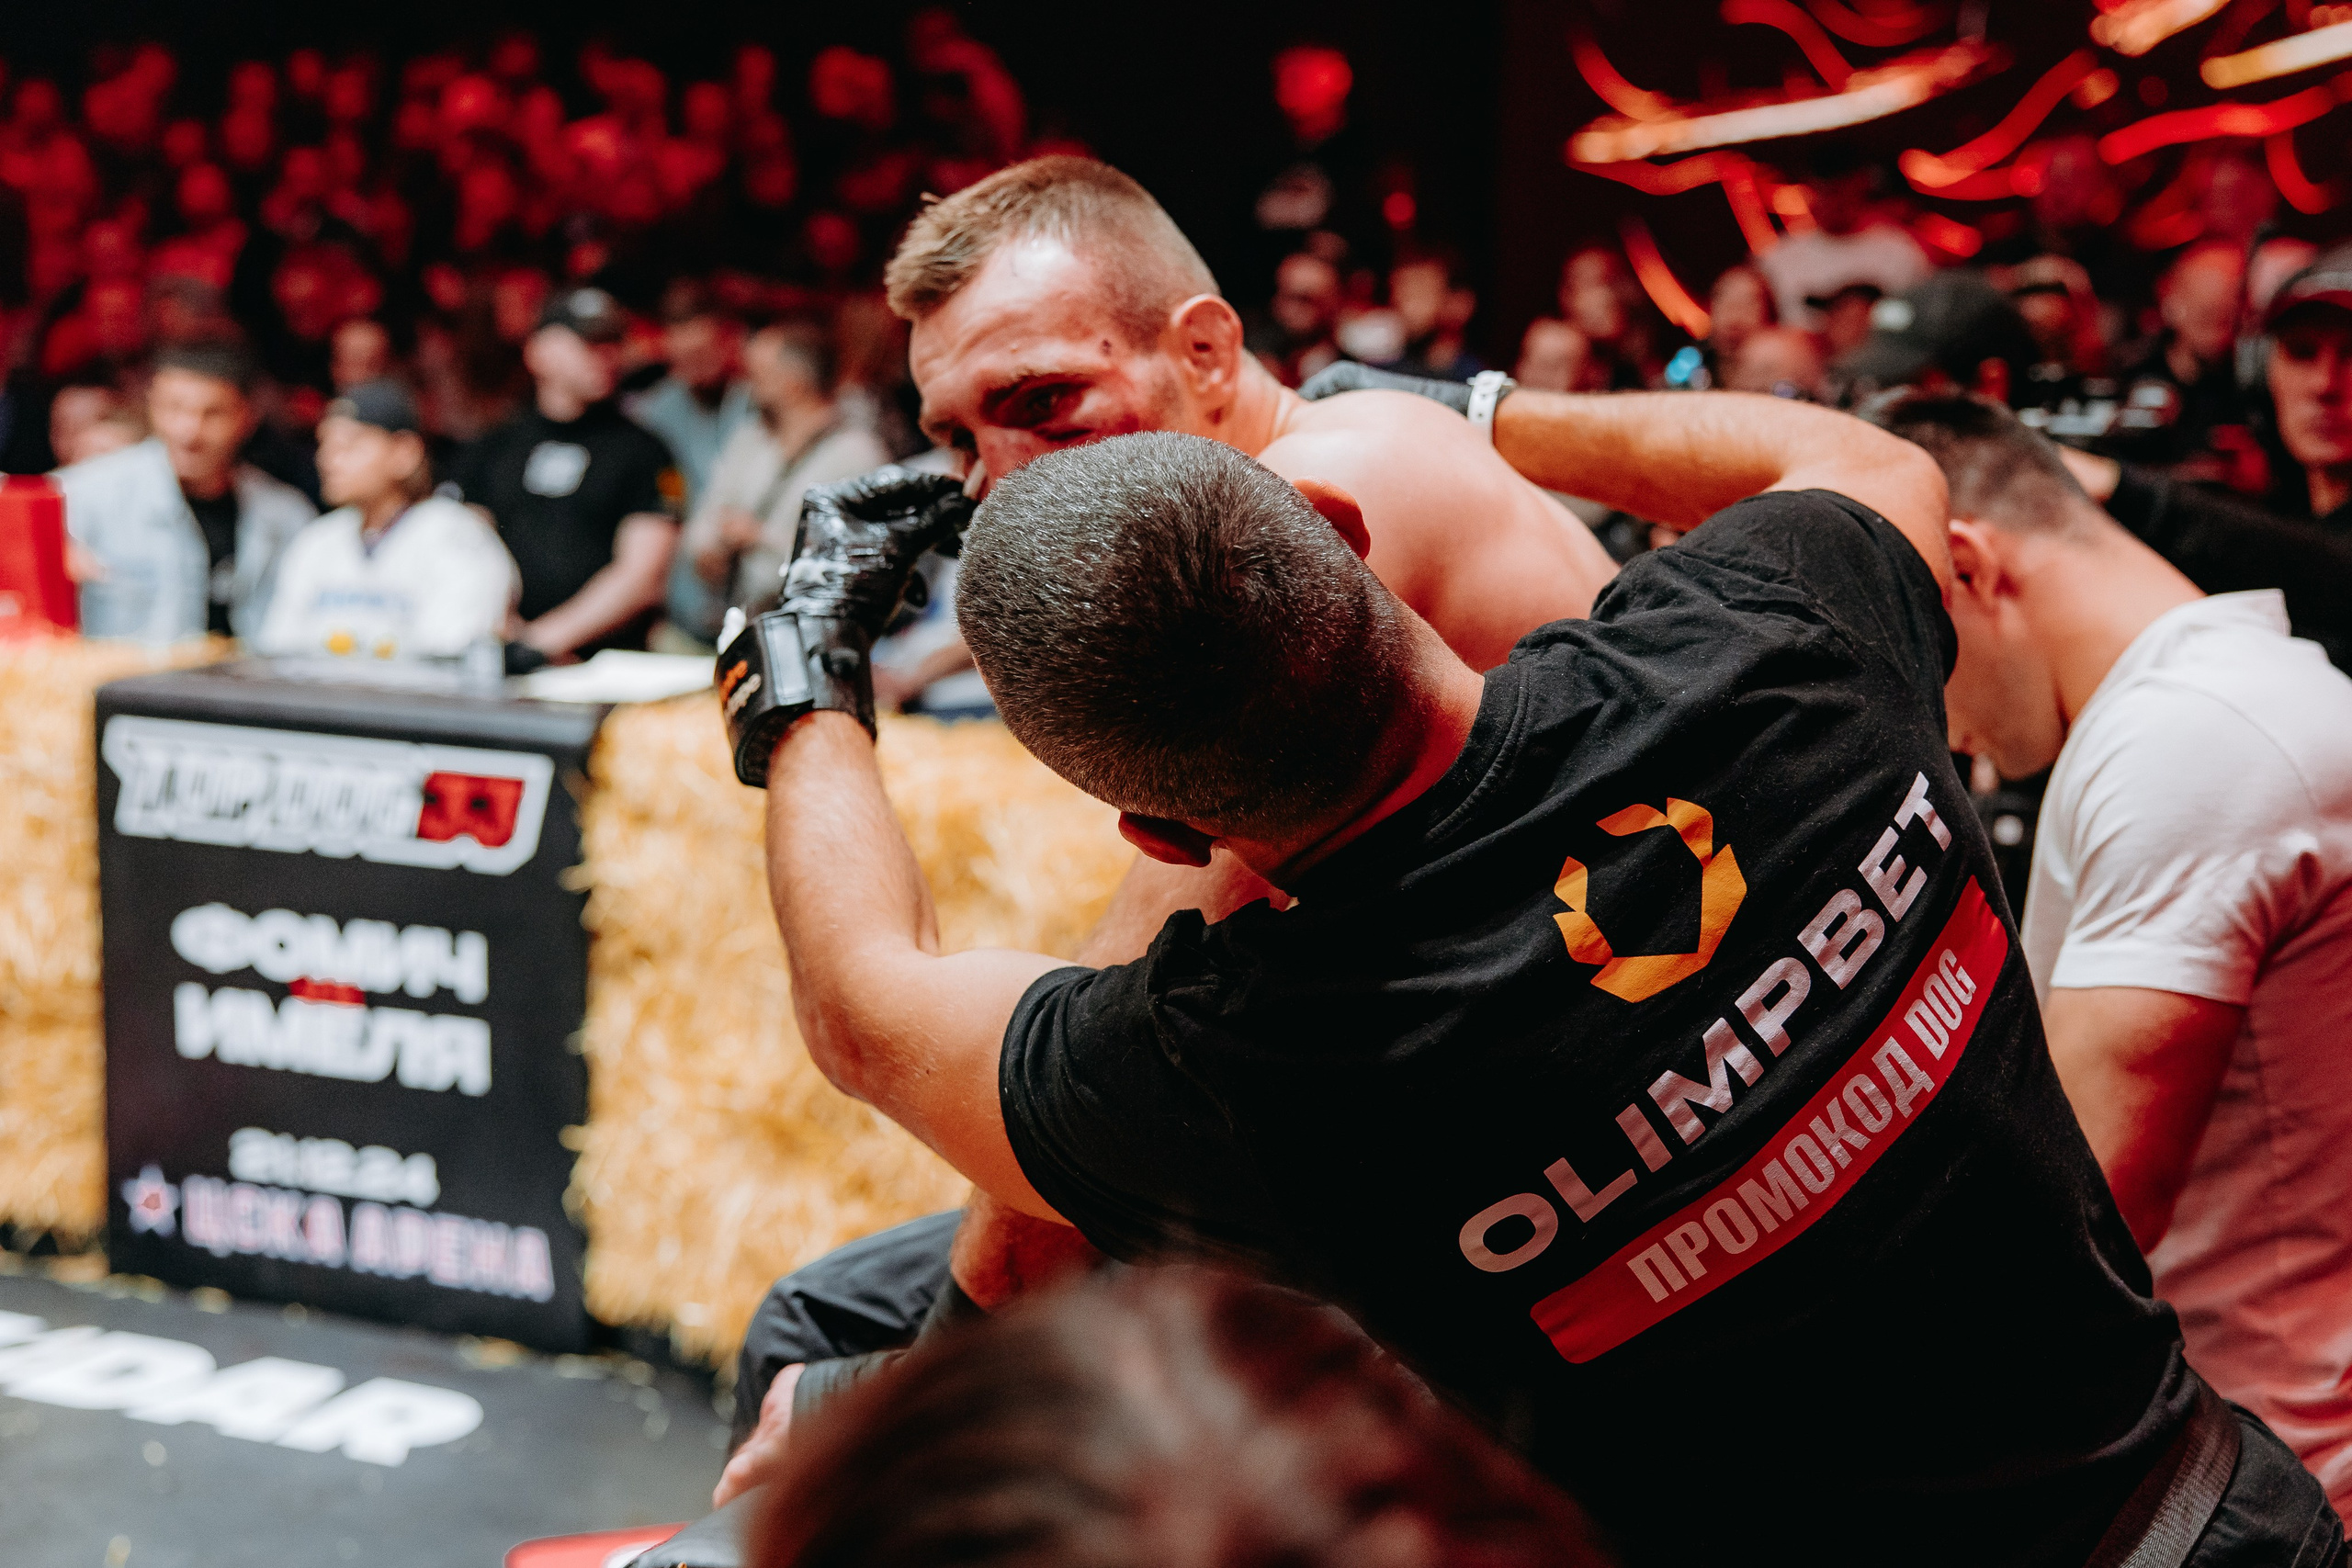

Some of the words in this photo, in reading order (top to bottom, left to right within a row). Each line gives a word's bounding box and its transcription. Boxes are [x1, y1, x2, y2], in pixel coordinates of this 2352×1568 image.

[1459, 771, 1952, 1272] OLIMPBET
[1626, 1035, 1935, 1303] ПРОМОКОД
[1903, 948, 1977, 1061] DOG
